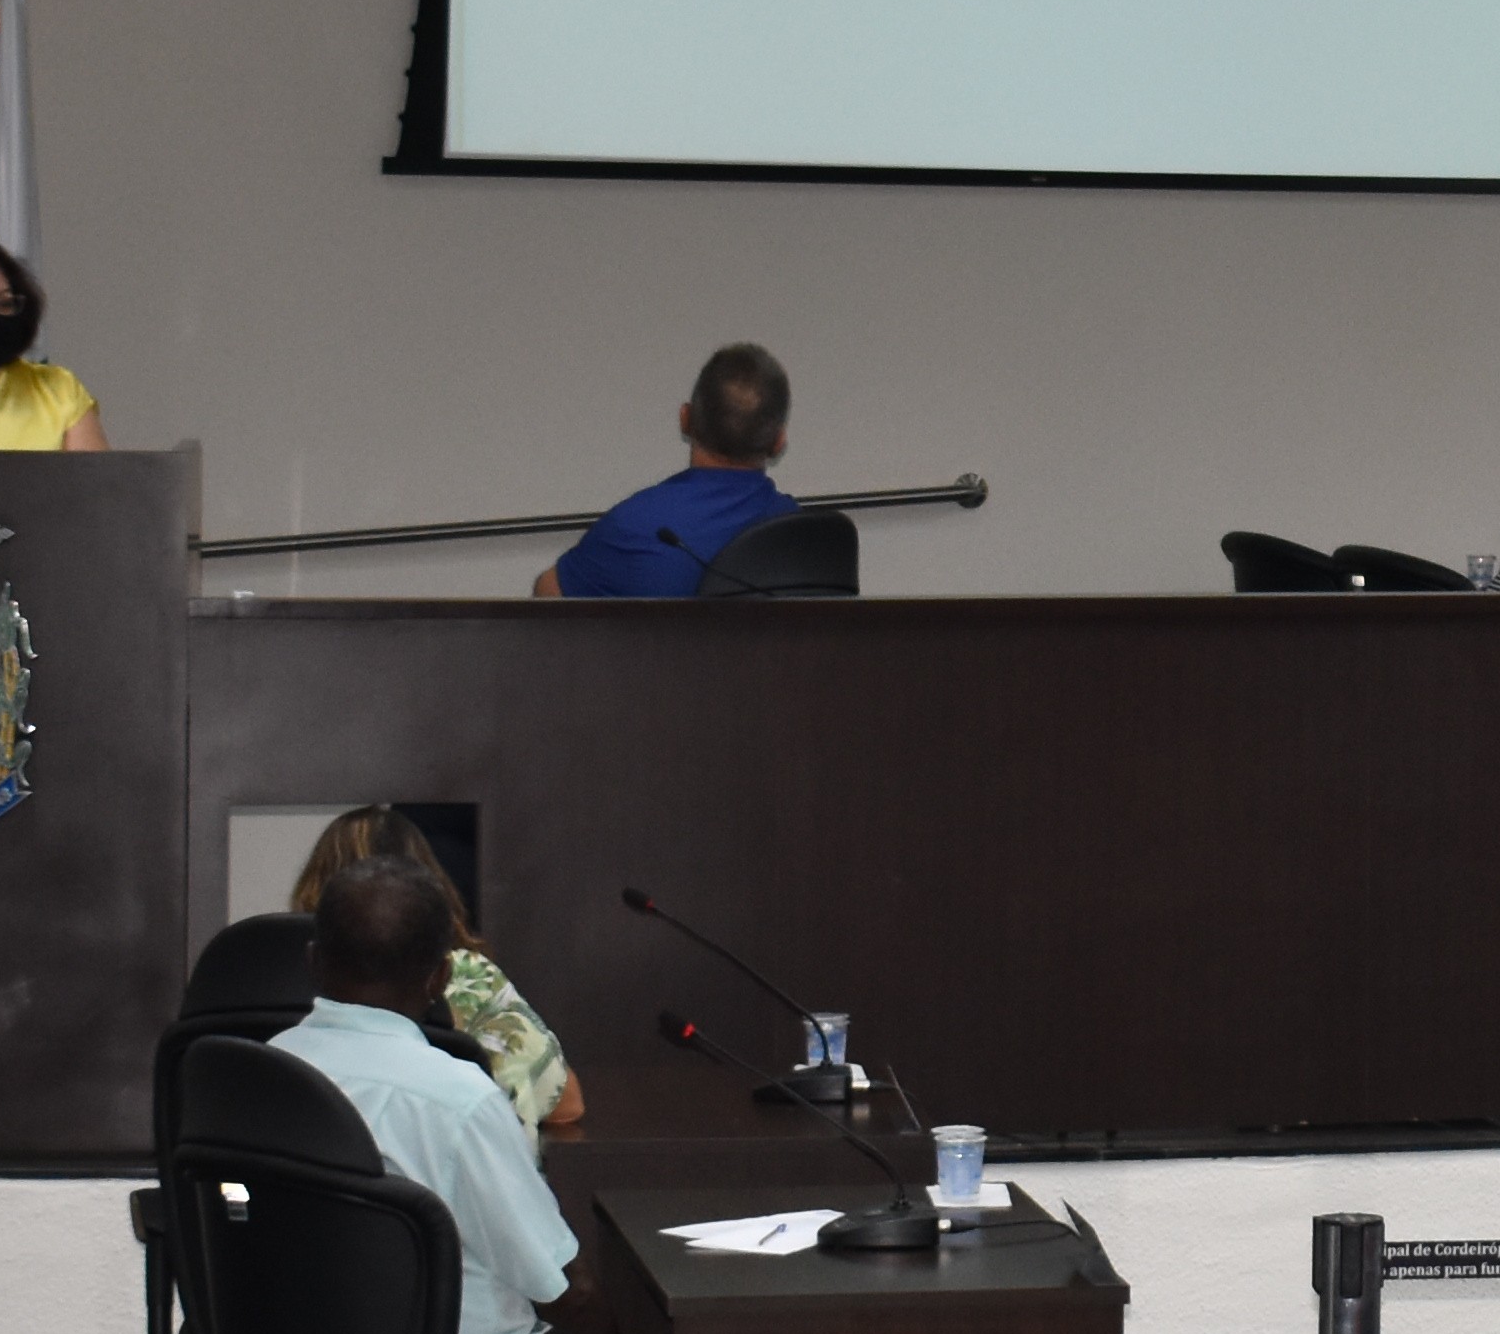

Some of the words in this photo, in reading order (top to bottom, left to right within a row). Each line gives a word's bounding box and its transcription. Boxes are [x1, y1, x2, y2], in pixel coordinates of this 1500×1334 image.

[1414, 1243, 1431, 1255] de
[1390, 1265, 1440, 1279] apenas
[1444, 1264, 1477, 1278] para
